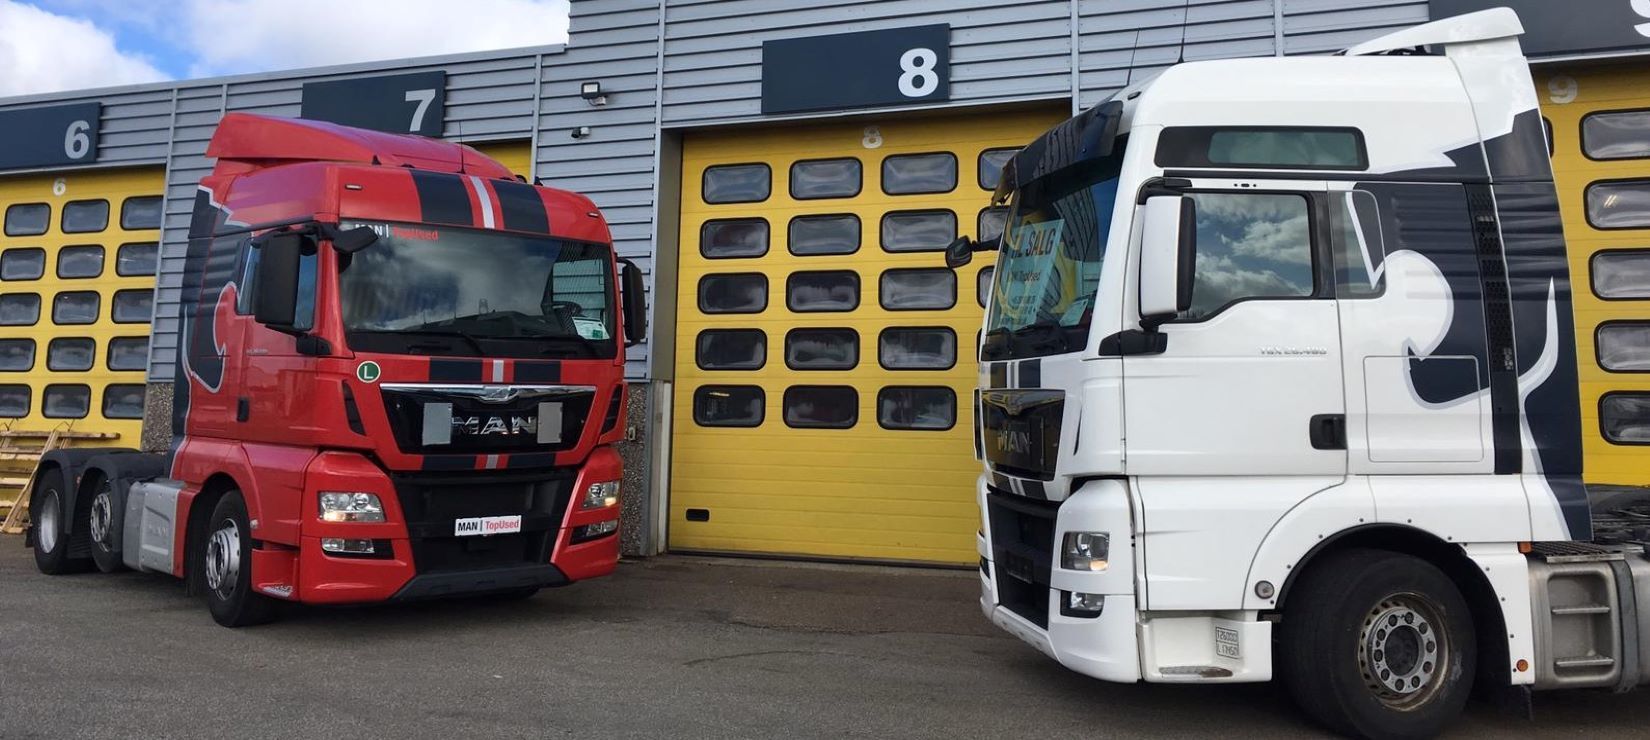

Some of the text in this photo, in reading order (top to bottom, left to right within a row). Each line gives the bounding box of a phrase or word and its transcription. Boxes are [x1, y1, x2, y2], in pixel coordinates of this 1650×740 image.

[898, 47, 939, 98] 8
[1548, 76, 1578, 104] 9
[405, 89, 436, 132] 7
[64, 119, 90, 159] 6
[862, 126, 882, 149] 8
[53, 177, 66, 196] 6
[363, 365, 375, 379] L
[451, 416, 537, 435] MAN
[998, 431, 1030, 454] MAN
[457, 519, 519, 532] MAN TopUsed
